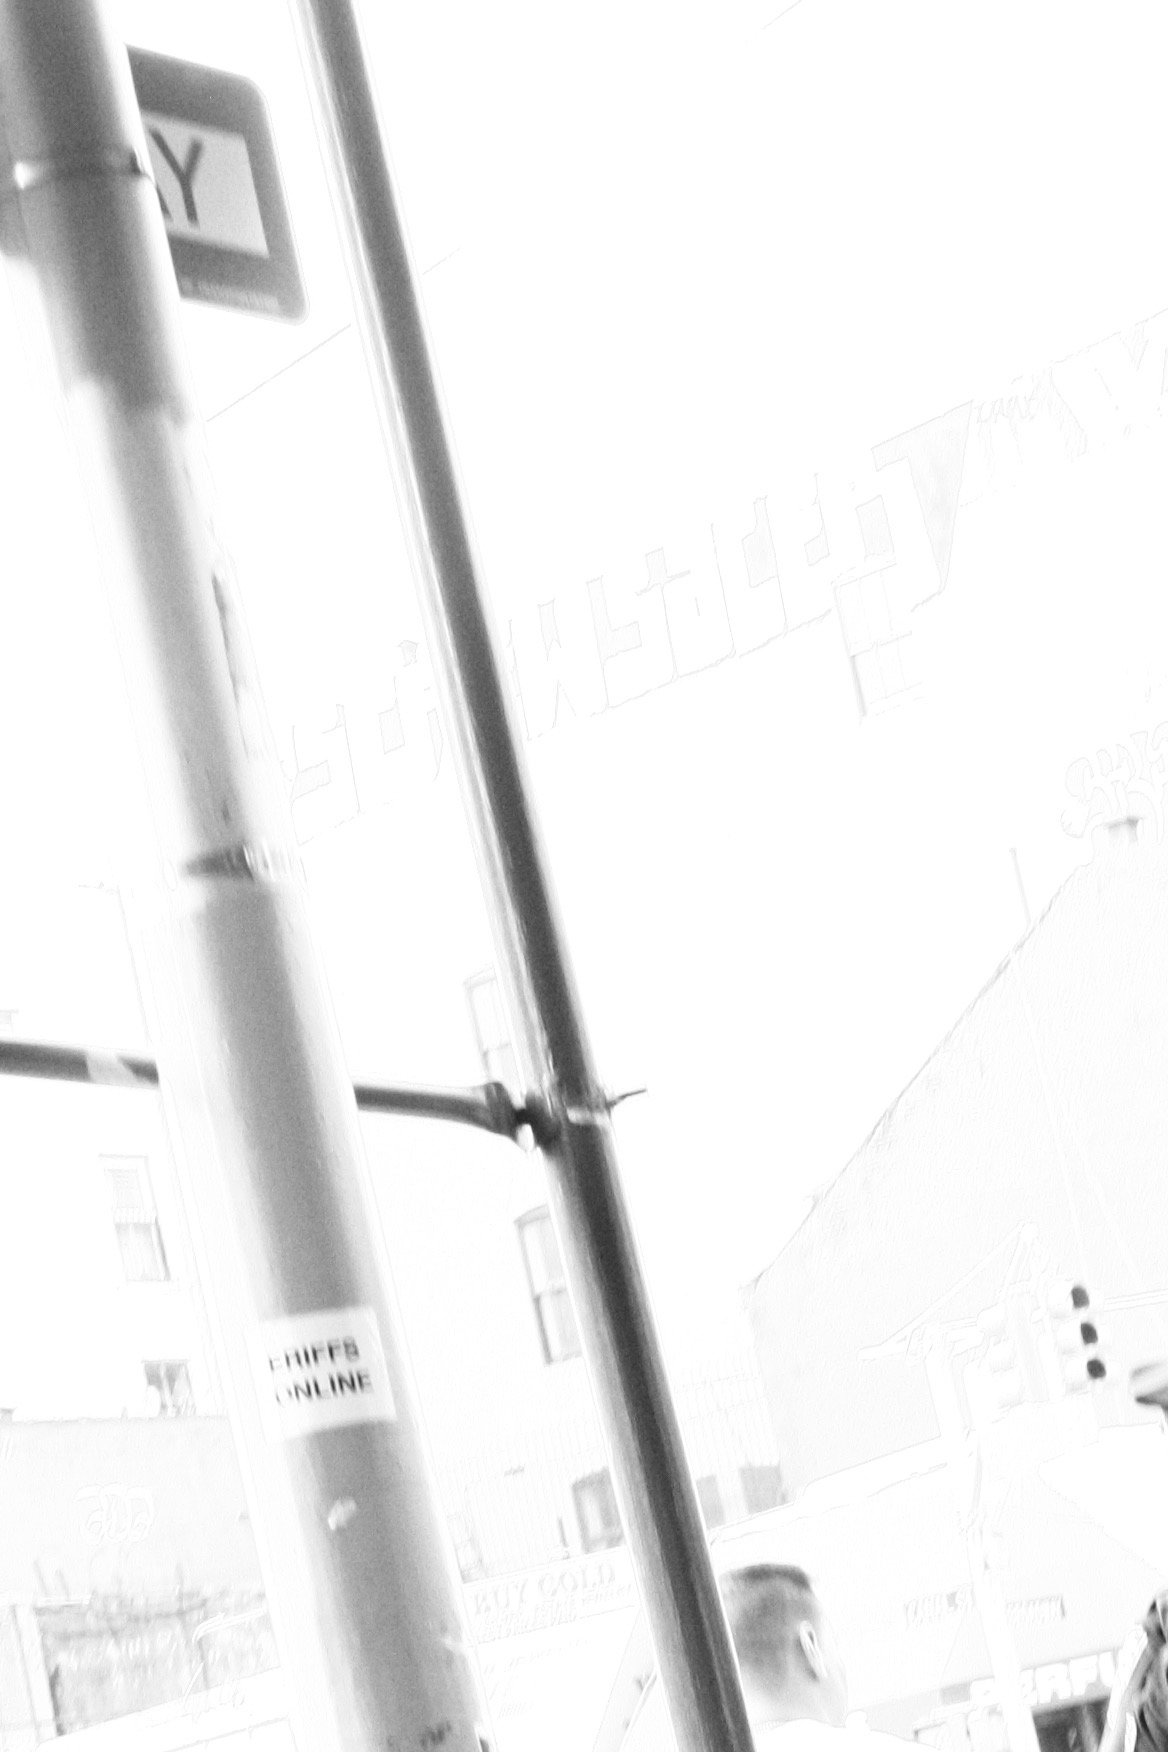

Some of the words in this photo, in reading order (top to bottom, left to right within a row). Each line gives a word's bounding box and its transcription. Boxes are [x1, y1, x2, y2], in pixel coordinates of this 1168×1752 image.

[148, 126, 204, 227] Y
[470, 1579, 533, 1615] BUY
[536, 1558, 618, 1600] GOLD
